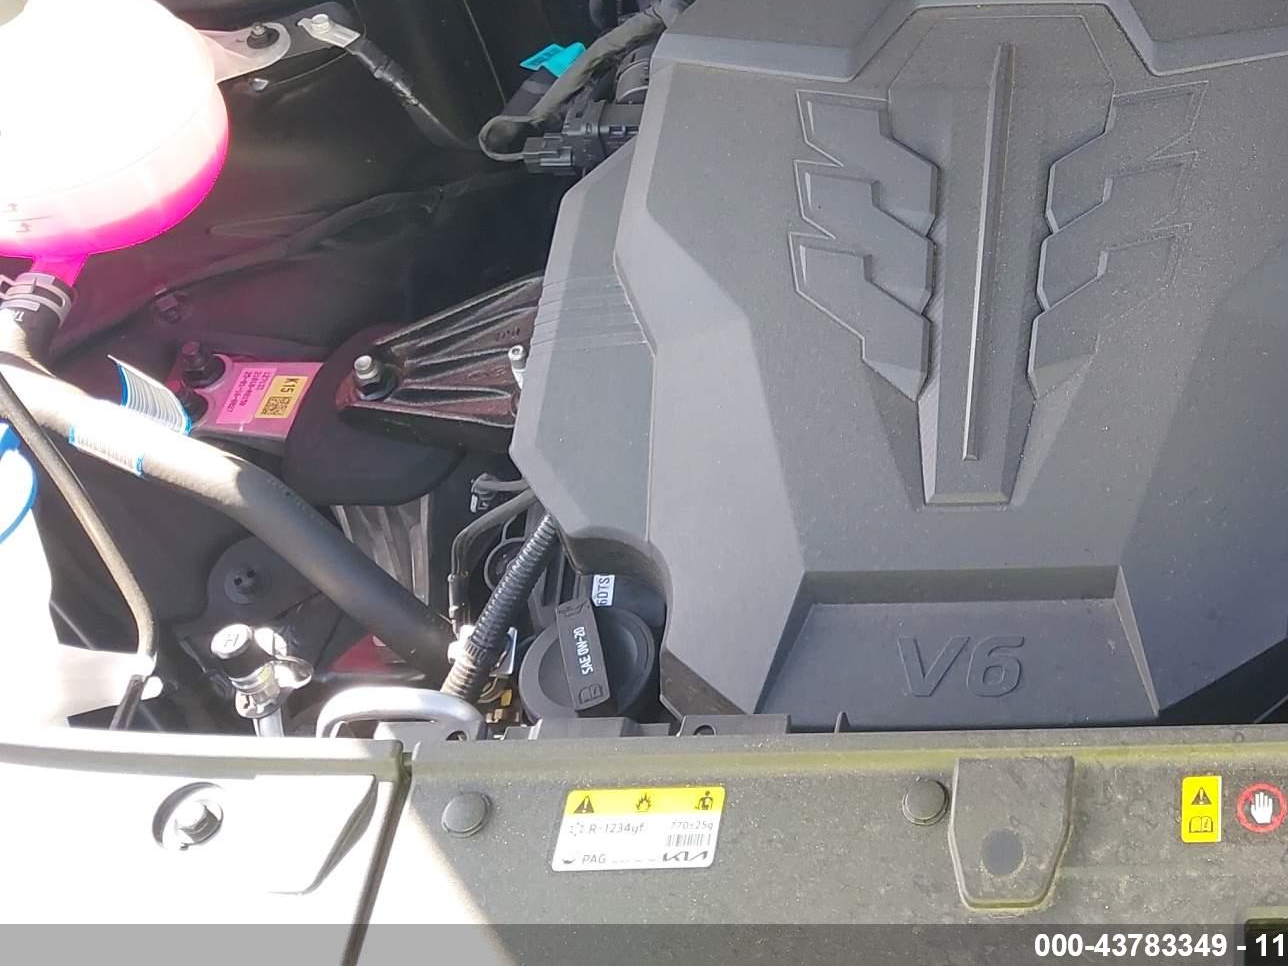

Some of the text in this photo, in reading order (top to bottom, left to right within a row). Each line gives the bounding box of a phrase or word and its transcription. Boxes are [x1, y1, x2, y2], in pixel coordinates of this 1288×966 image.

[280, 377, 300, 394] K15
[573, 626, 594, 675] SAE 0W-20
[897, 635, 1025, 698] V6
[581, 853, 607, 865] PAG
